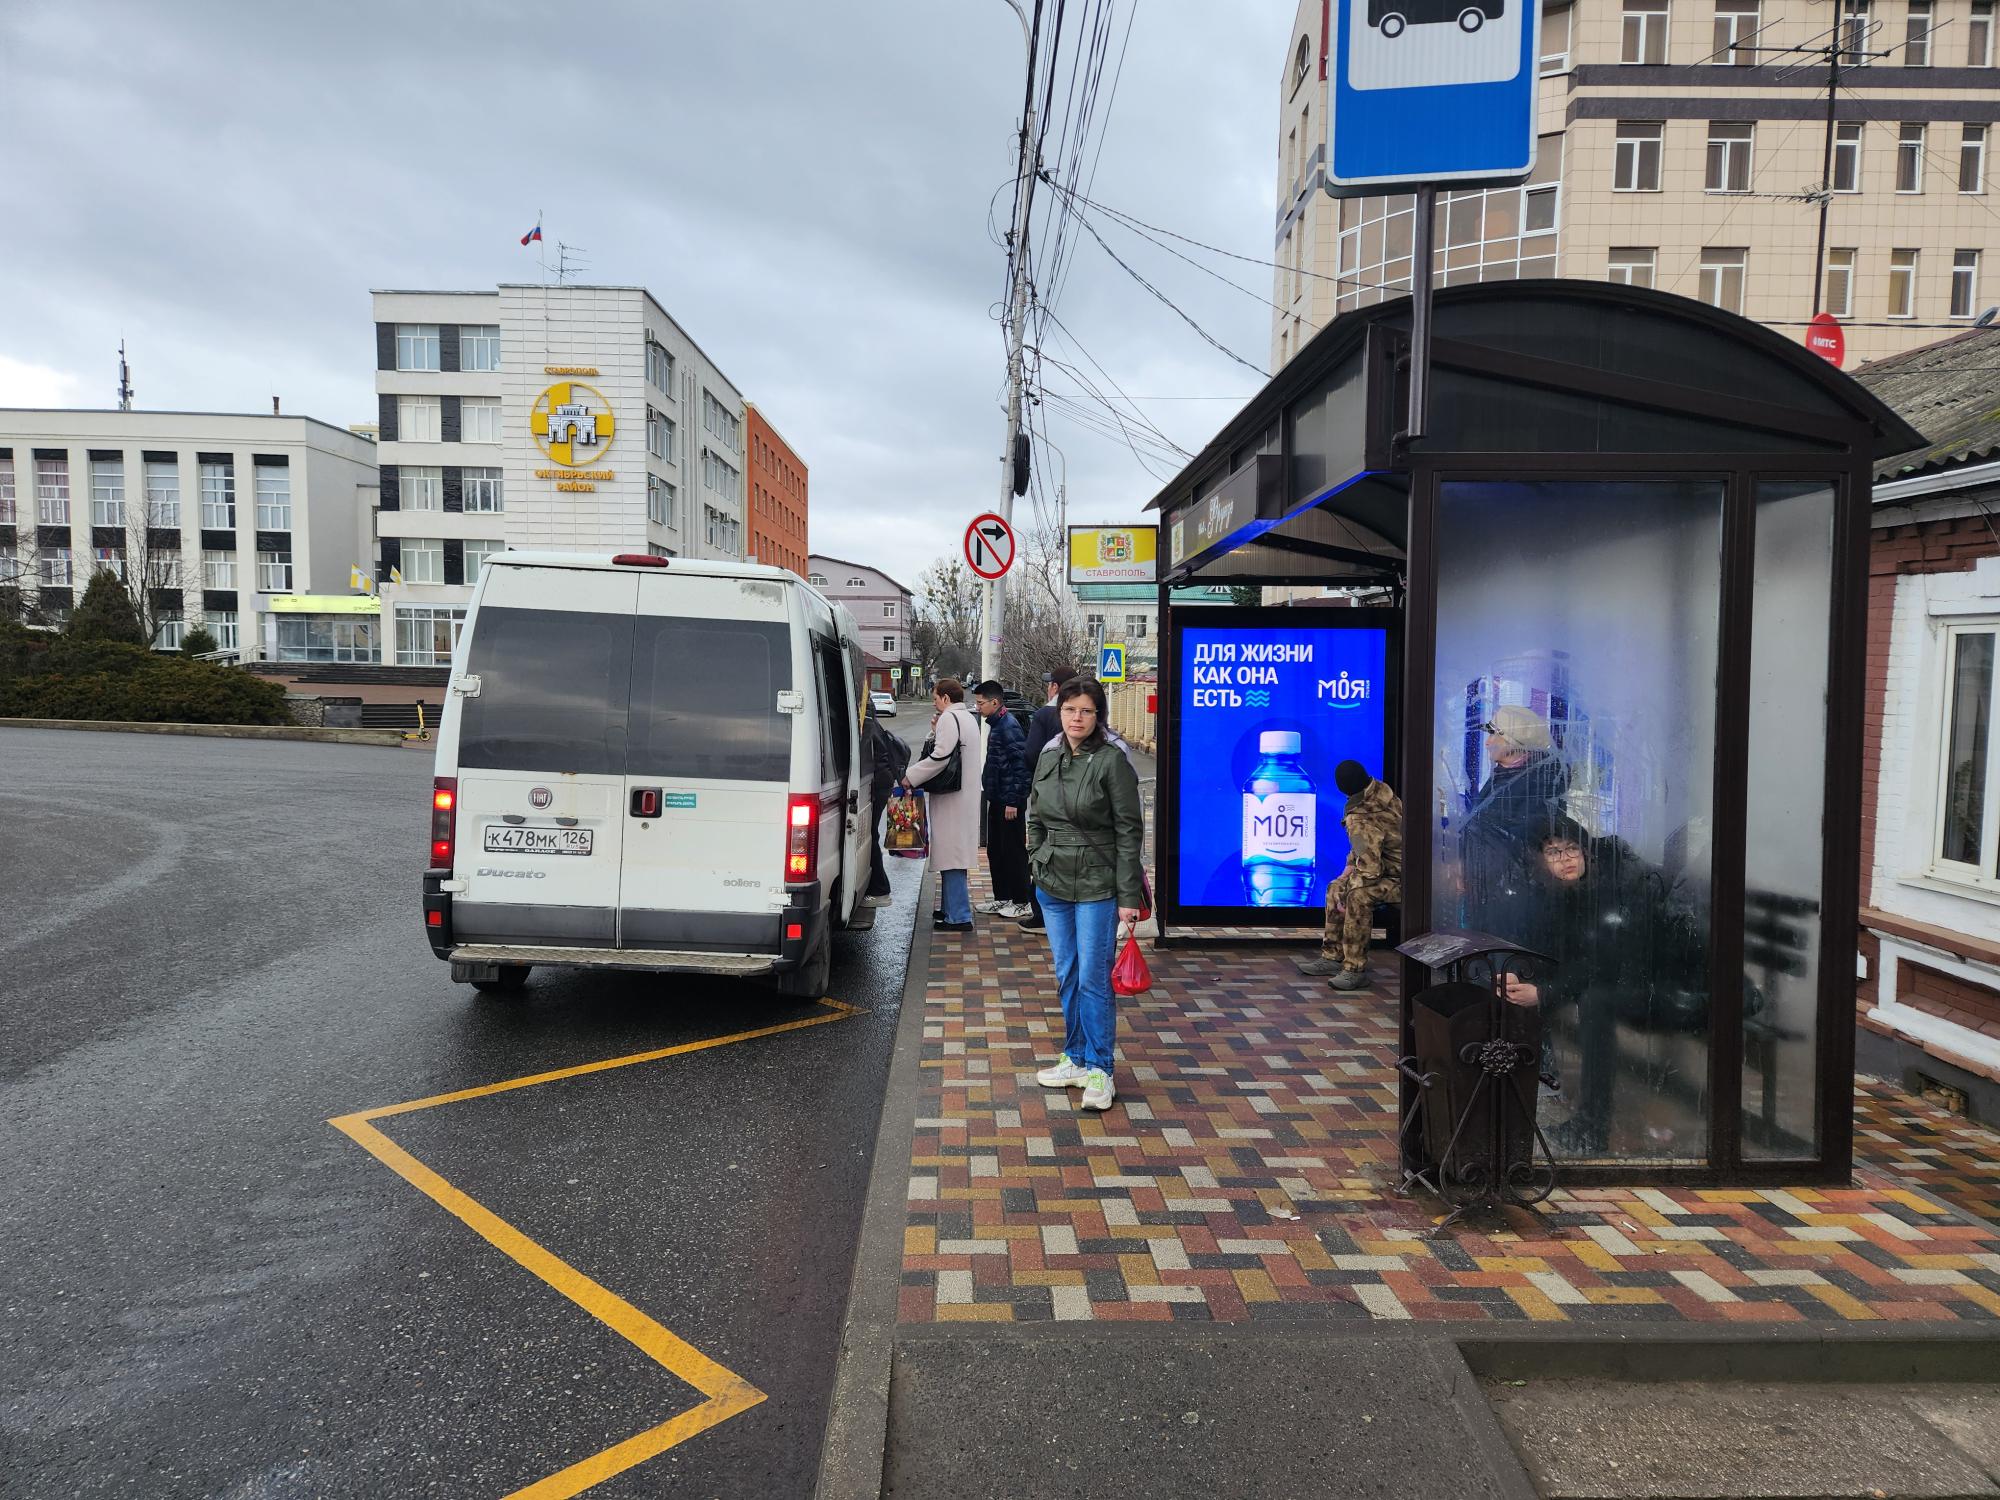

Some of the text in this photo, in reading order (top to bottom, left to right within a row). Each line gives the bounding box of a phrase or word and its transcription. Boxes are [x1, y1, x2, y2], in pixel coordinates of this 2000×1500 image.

[1816, 337, 1836, 348] МТС
[556, 481, 595, 492] РАЙОН
[1085, 569, 1146, 577] СТАВРОПОЛЬ
[1193, 643, 1313, 665] ДЛЯ ЖИЗНИ
[1193, 666, 1279, 685] КАК ОНА
[1193, 688, 1242, 708] ЕСТЬ
[533, 792, 548, 804] FIAT
[562, 832, 588, 845] 126
[476, 866, 547, 880] Ducato
